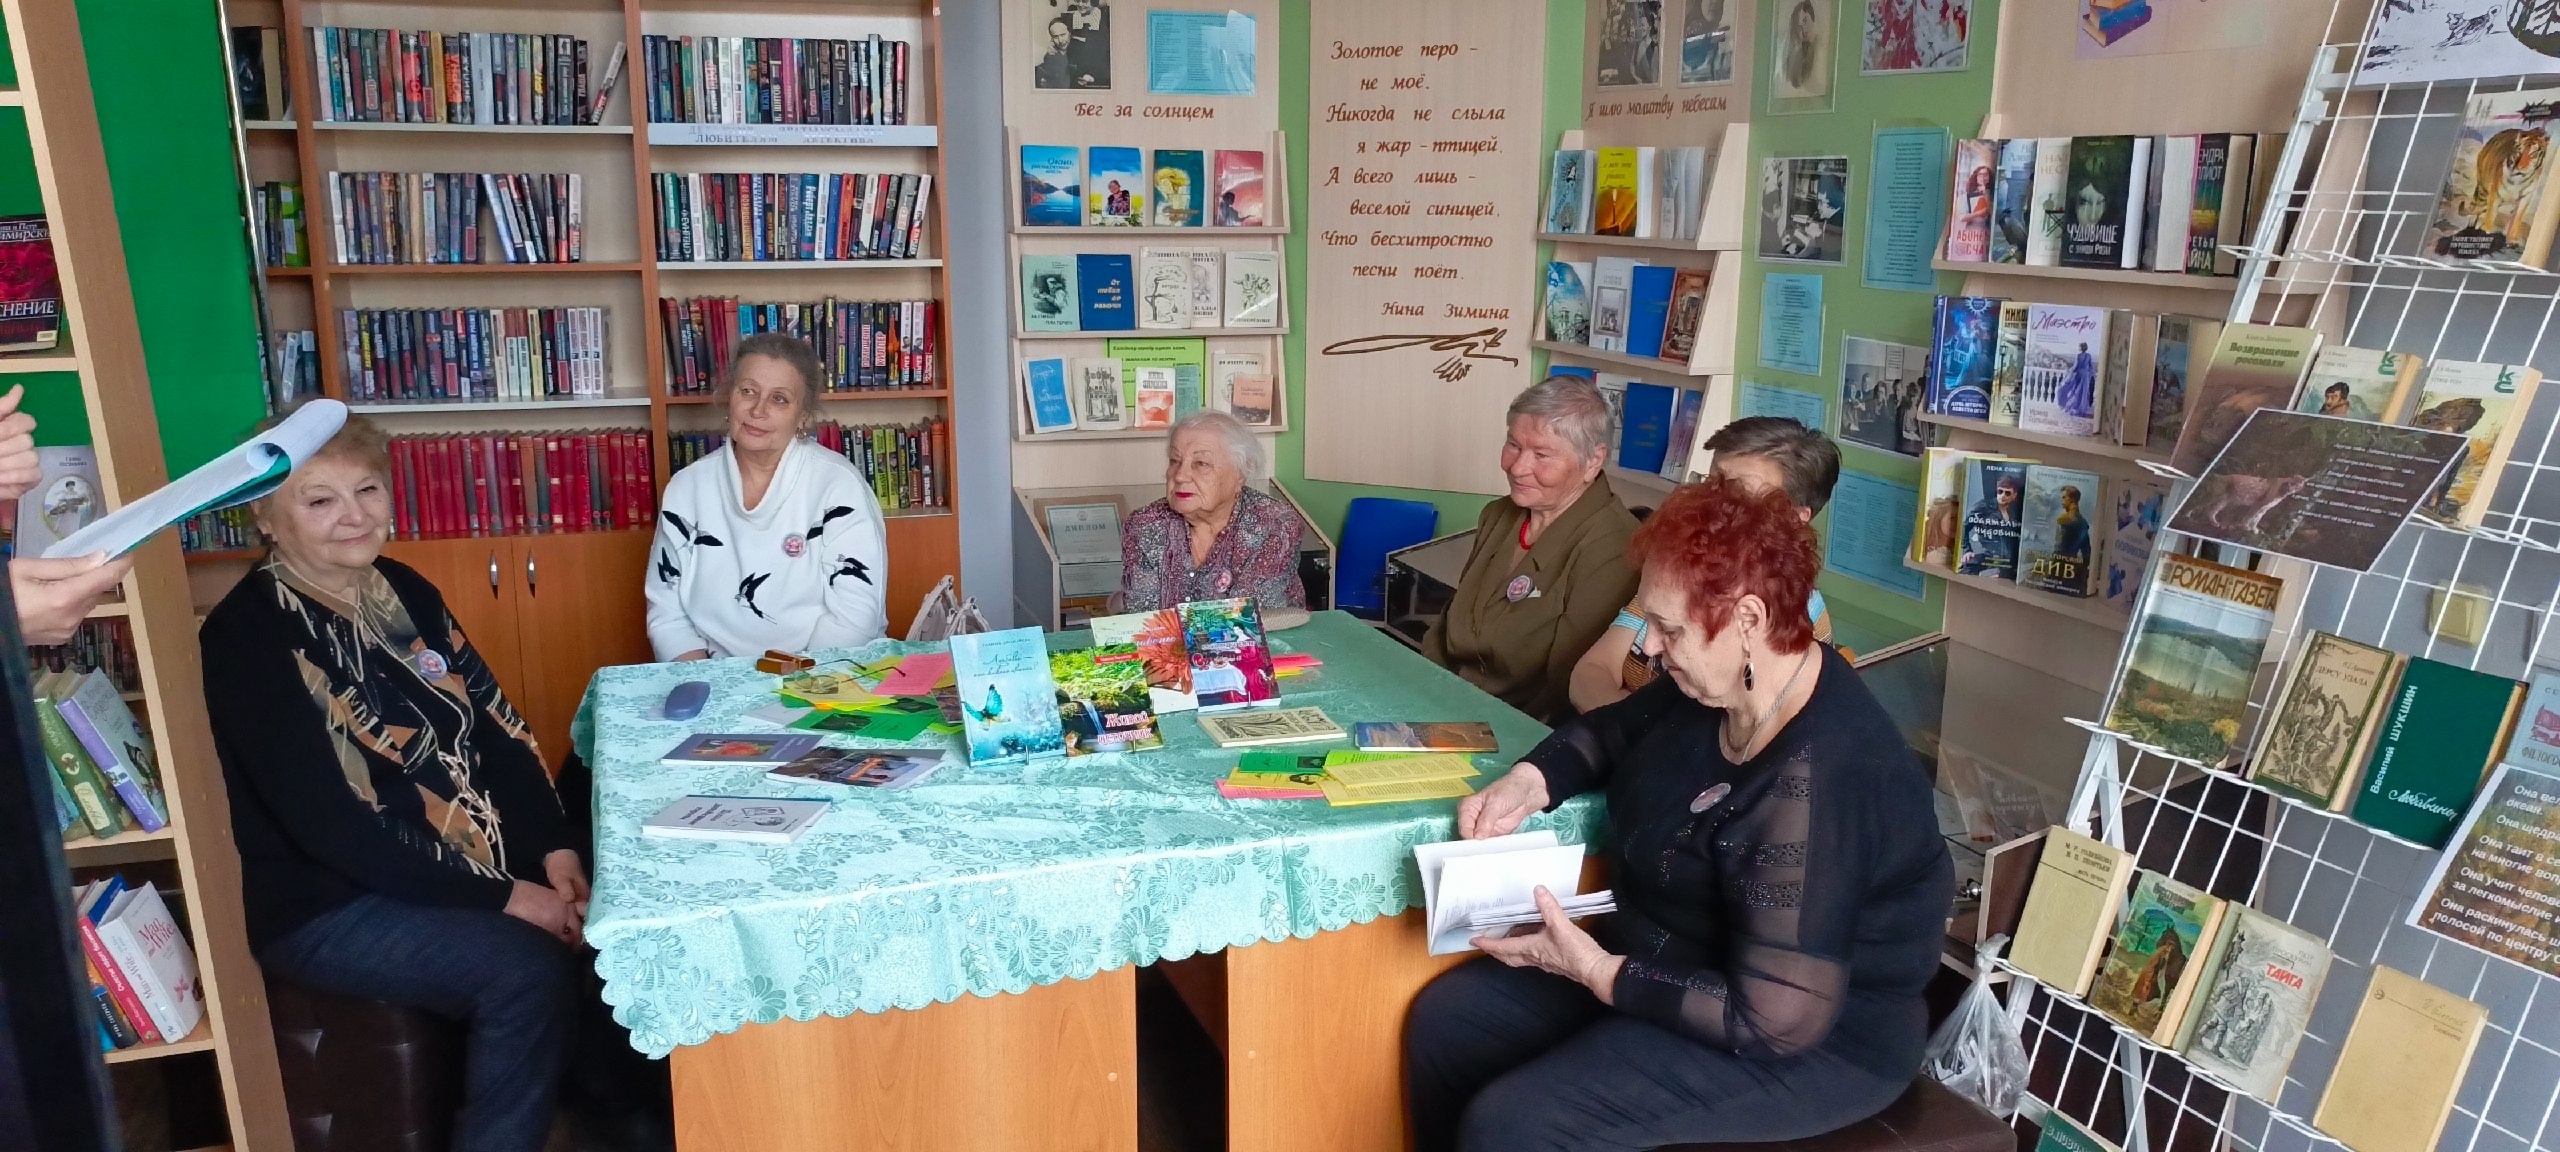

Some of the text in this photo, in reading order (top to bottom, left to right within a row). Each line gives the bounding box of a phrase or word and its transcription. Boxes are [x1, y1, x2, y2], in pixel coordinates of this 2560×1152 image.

[1331, 40, 1404, 60] Золотое
[1421, 43, 1458, 62] перо
[1360, 73, 1430, 90] не моё.
[1074, 103, 1214, 122] Бег за солнцем
[1326, 103, 1506, 123] Никогда не слыла
[1585, 94, 1727, 122] Я шлю молитву небесам
[1357, 141, 1366, 154] я
[1376, 139, 1411, 157] жар
[1324, 167, 1340, 187] А
[1354, 167, 1394, 185] всего
[1414, 172, 1458, 184] лишь
[1350, 199, 1411, 216] веселой
[1321, 230, 1493, 250] Что бесхитростно
[2067, 224, 2118, 243] ЧУДОВИЩЕ
[2189, 236, 2214, 249] ЕТЬЯ
[2189, 249, 2211, 269] ЙНА
[1352, 264, 1464, 280] песни поёт.
[1381, 302, 1510, 320] Нина Зимина
[2032, 311, 2097, 334] Маэстро
[875, 332, 886, 366] КИЛЛЕР
[2229, 342, 2300, 358] Возвращение
[1065, 523, 1107, 533] ДИПЛОМ
[2032, 559, 2076, 579] ДИВ
[2170, 565, 2281, 610] РОМАН ГАЗЕТА
[2370, 685, 2418, 794] Василий ШУКШИН
[2515, 785, 2537, 799] Она
[2388, 790, 2457, 821] Любавины
[2506, 799, 2543, 816] океан.
[2497, 814, 2520, 829] Она
[2480, 834, 2503, 850] Она
[2506, 842, 2533, 859] таит
[2535, 852, 2543, 861] в
[2471, 848, 2486, 860] на
[2488, 854, 2534, 875] многие
[2460, 866, 2484, 882] Она
[2484, 873, 2515, 892] учит
[2453, 880, 2553, 921] за легкомыслие
[2441, 897, 2464, 914] Она
[2466, 905, 2547, 943] раскинулась
[2433, 911, 2551, 962] полосой по центру
[2266, 963, 2304, 990] ТАЙГА
